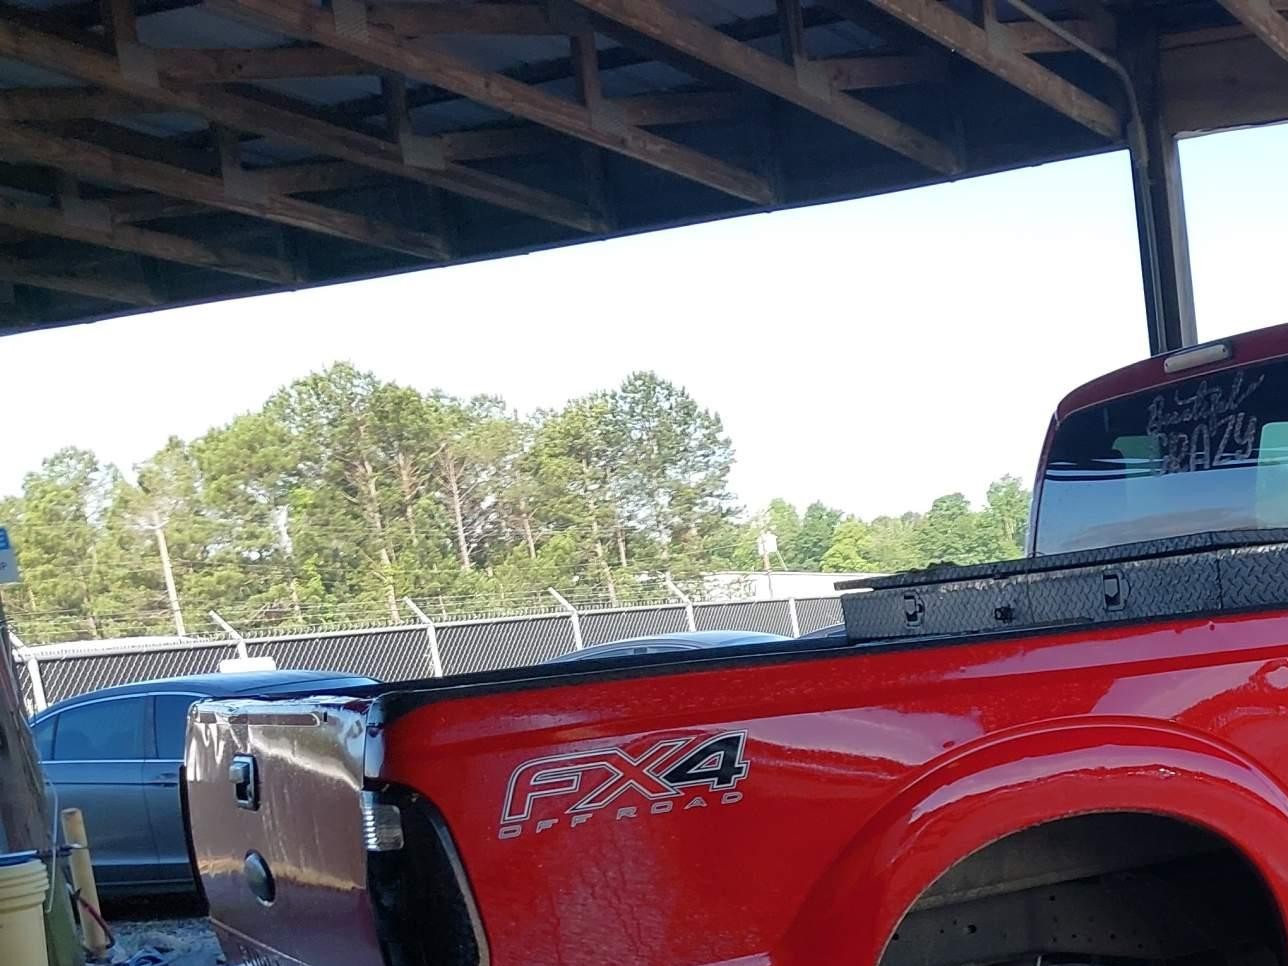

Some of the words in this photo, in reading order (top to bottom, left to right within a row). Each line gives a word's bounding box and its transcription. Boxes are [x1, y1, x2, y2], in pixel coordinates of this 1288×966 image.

[500, 728, 751, 824] FX4
[498, 813, 593, 840] OFF
[616, 791, 743, 820] ROAD
